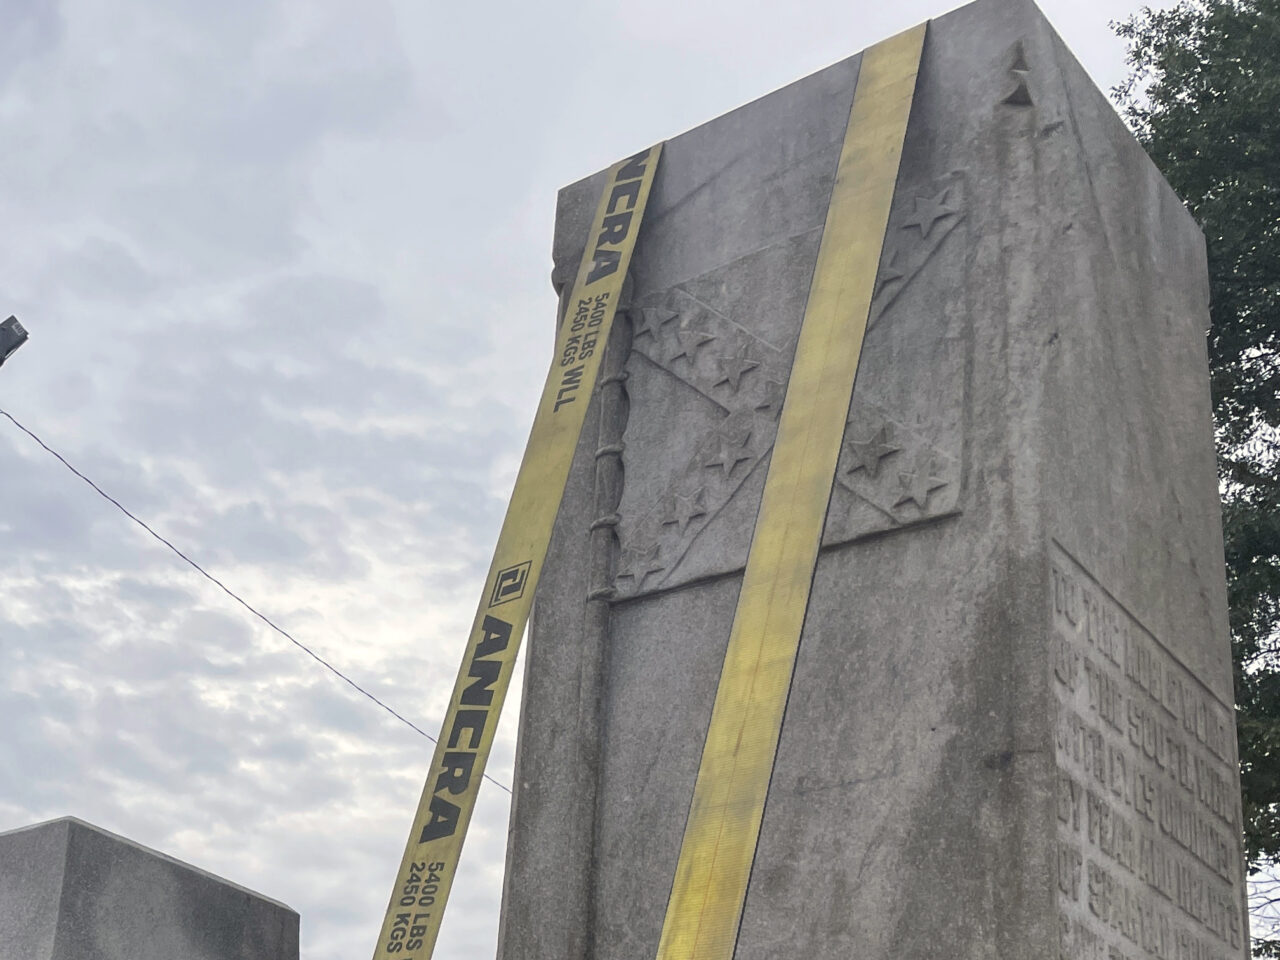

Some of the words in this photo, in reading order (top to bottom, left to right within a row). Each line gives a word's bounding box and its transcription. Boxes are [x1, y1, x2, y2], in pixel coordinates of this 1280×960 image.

[585, 147, 653, 286] NCRA
[573, 298, 593, 333] 2450
[588, 293, 610, 328] 5400
[561, 335, 583, 365] KGS
[578, 329, 599, 360] LBS
[553, 366, 584, 413] WLL
[418, 614, 513, 844] ANCRA
[400, 861, 426, 907] 2450
[422, 861, 445, 906] 5400
[387, 913, 410, 954] KGS
[406, 912, 430, 951] LBS
